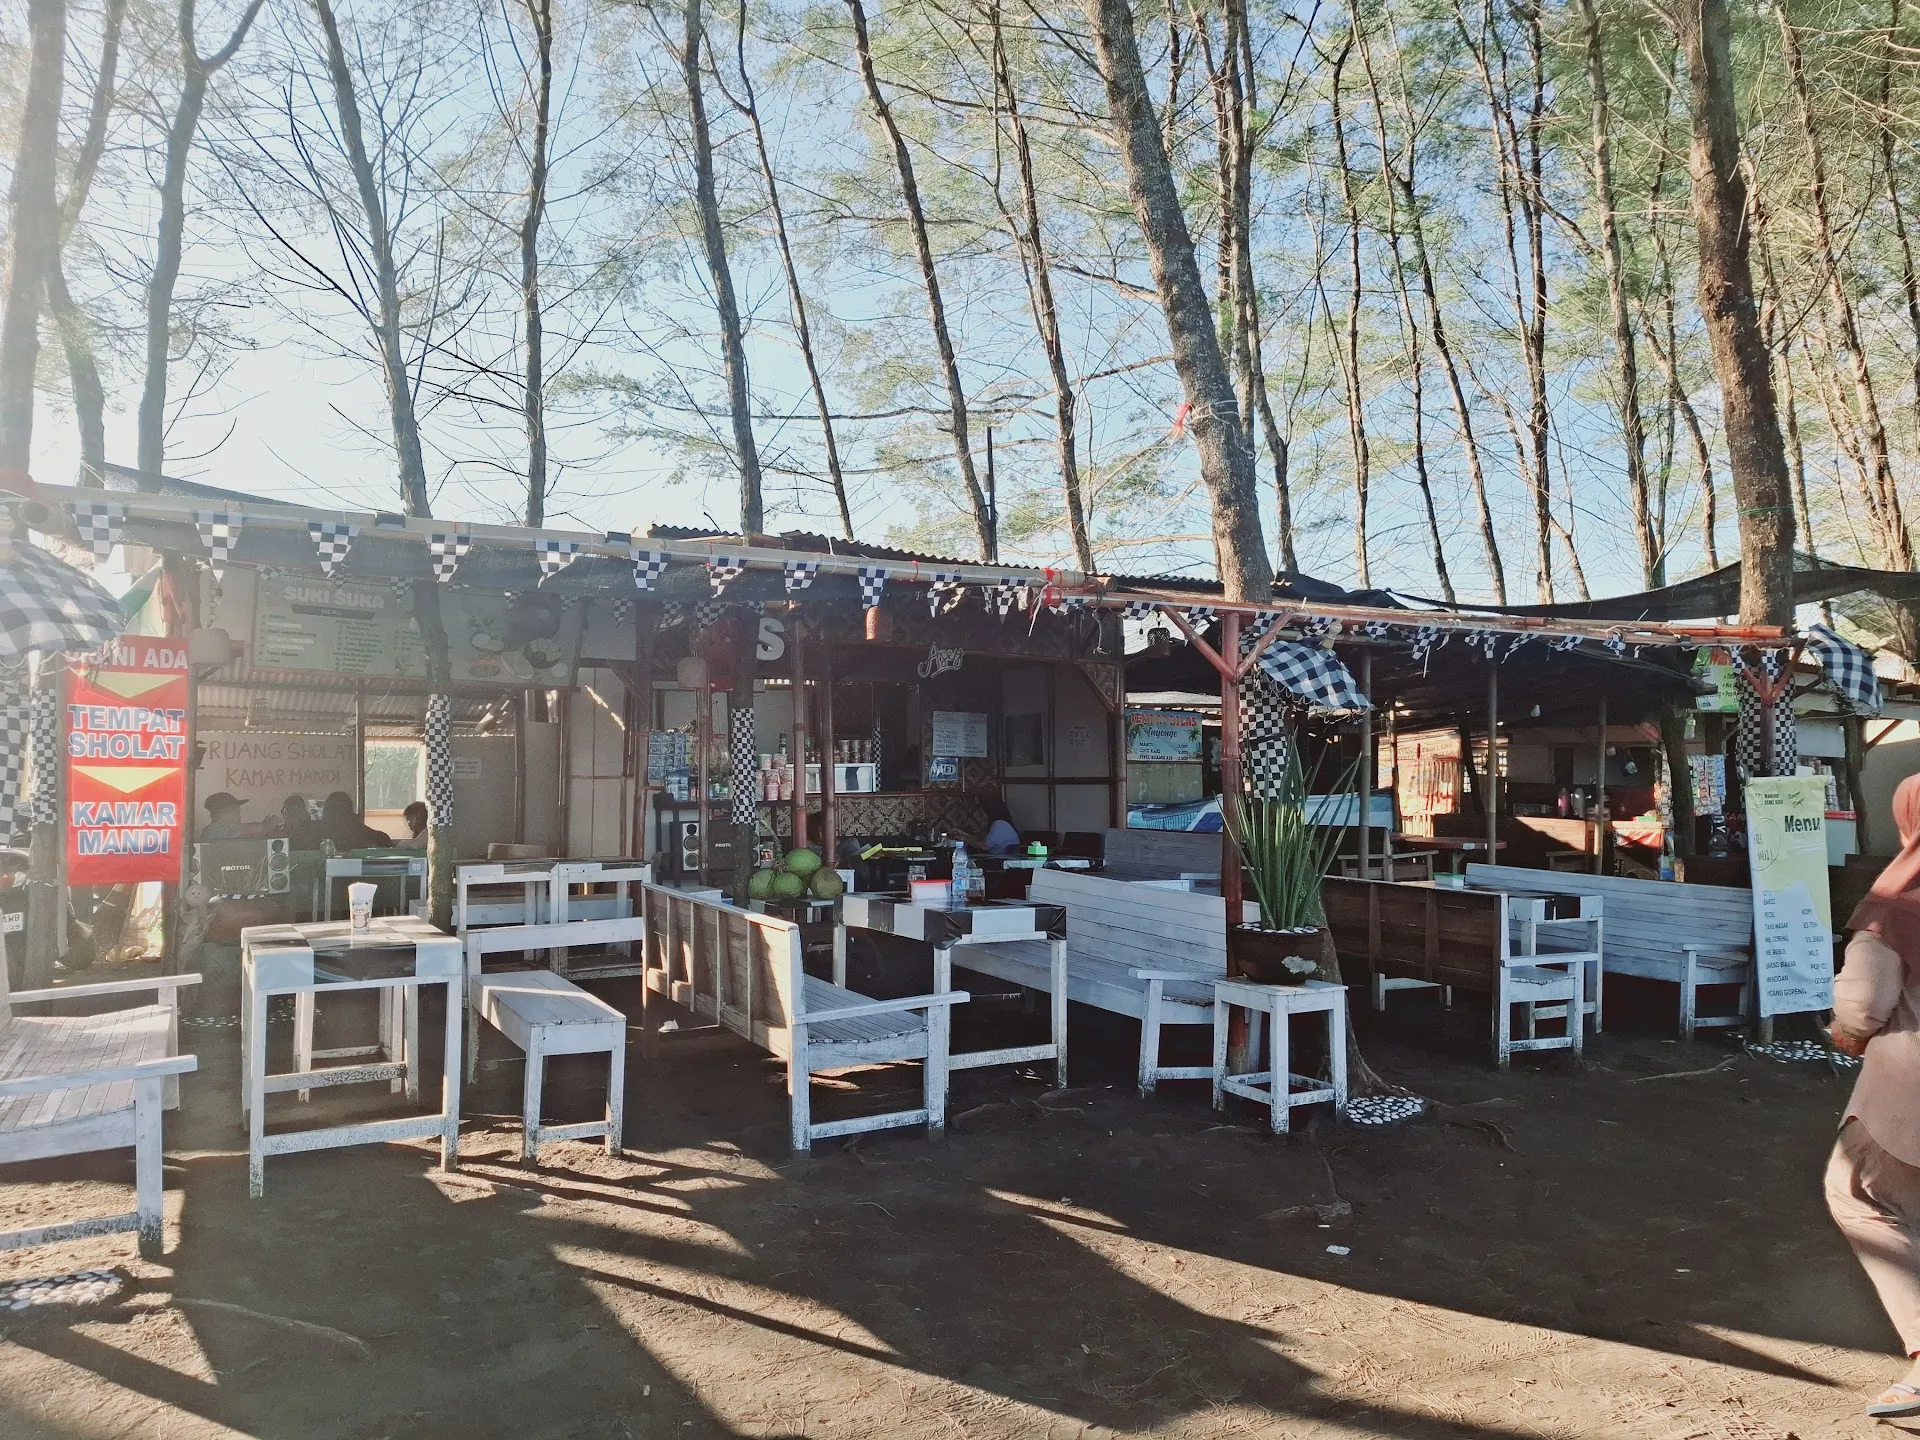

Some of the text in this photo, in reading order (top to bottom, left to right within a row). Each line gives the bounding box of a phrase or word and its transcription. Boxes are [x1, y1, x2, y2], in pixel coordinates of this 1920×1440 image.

[284, 586, 385, 608] SUKI SUKA
[143, 648, 189, 669] ADA
[67, 704, 185, 732] TEMPAT
[68, 732, 186, 759] SHOLAT
[209, 740, 356, 760] RUANG SHOLAT
[225, 766, 341, 788] KAMAR MANDI
[72, 801, 176, 827] KAMAR
[1784, 815, 1820, 833] Menu
[78, 829, 170, 855] MANDI
[1784, 988, 1807, 996] GORENG
